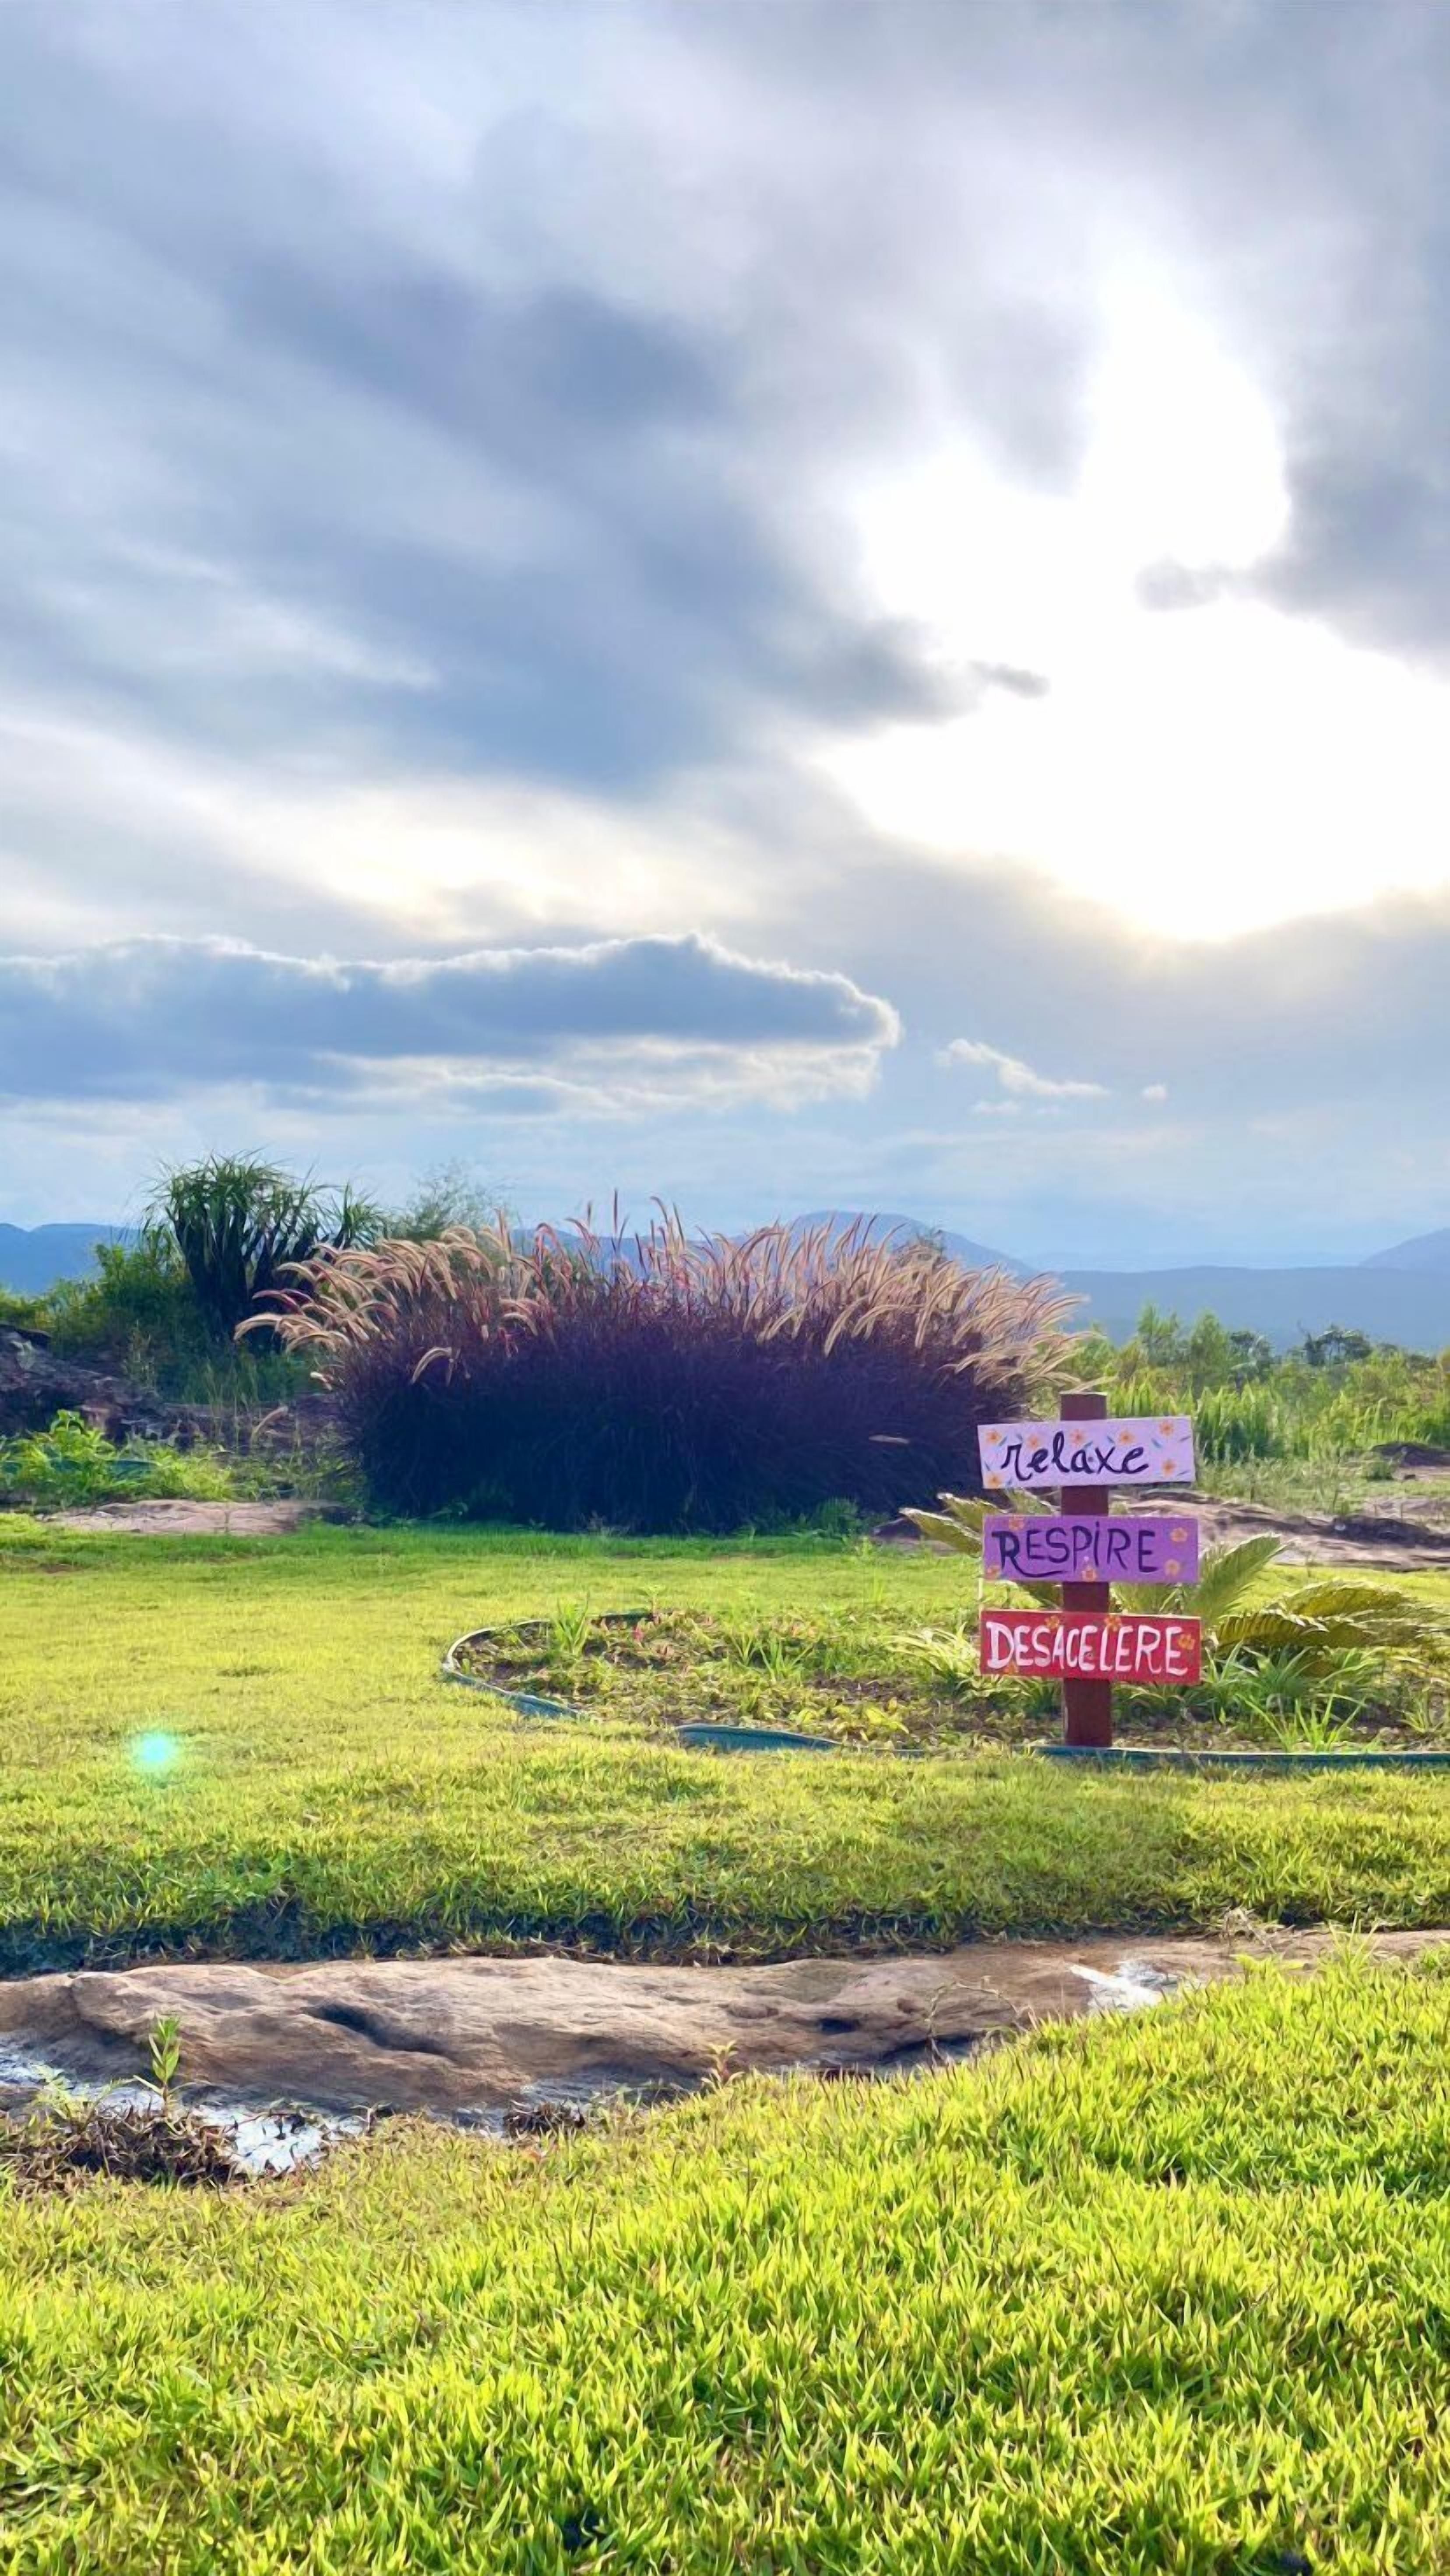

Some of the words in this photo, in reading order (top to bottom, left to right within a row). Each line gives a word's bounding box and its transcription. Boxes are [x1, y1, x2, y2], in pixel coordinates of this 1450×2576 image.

[1000, 1431, 1149, 1482] relaxe
[992, 1521, 1159, 1577] RESPIRE
[985, 1622, 1188, 1675] DESACELERE
